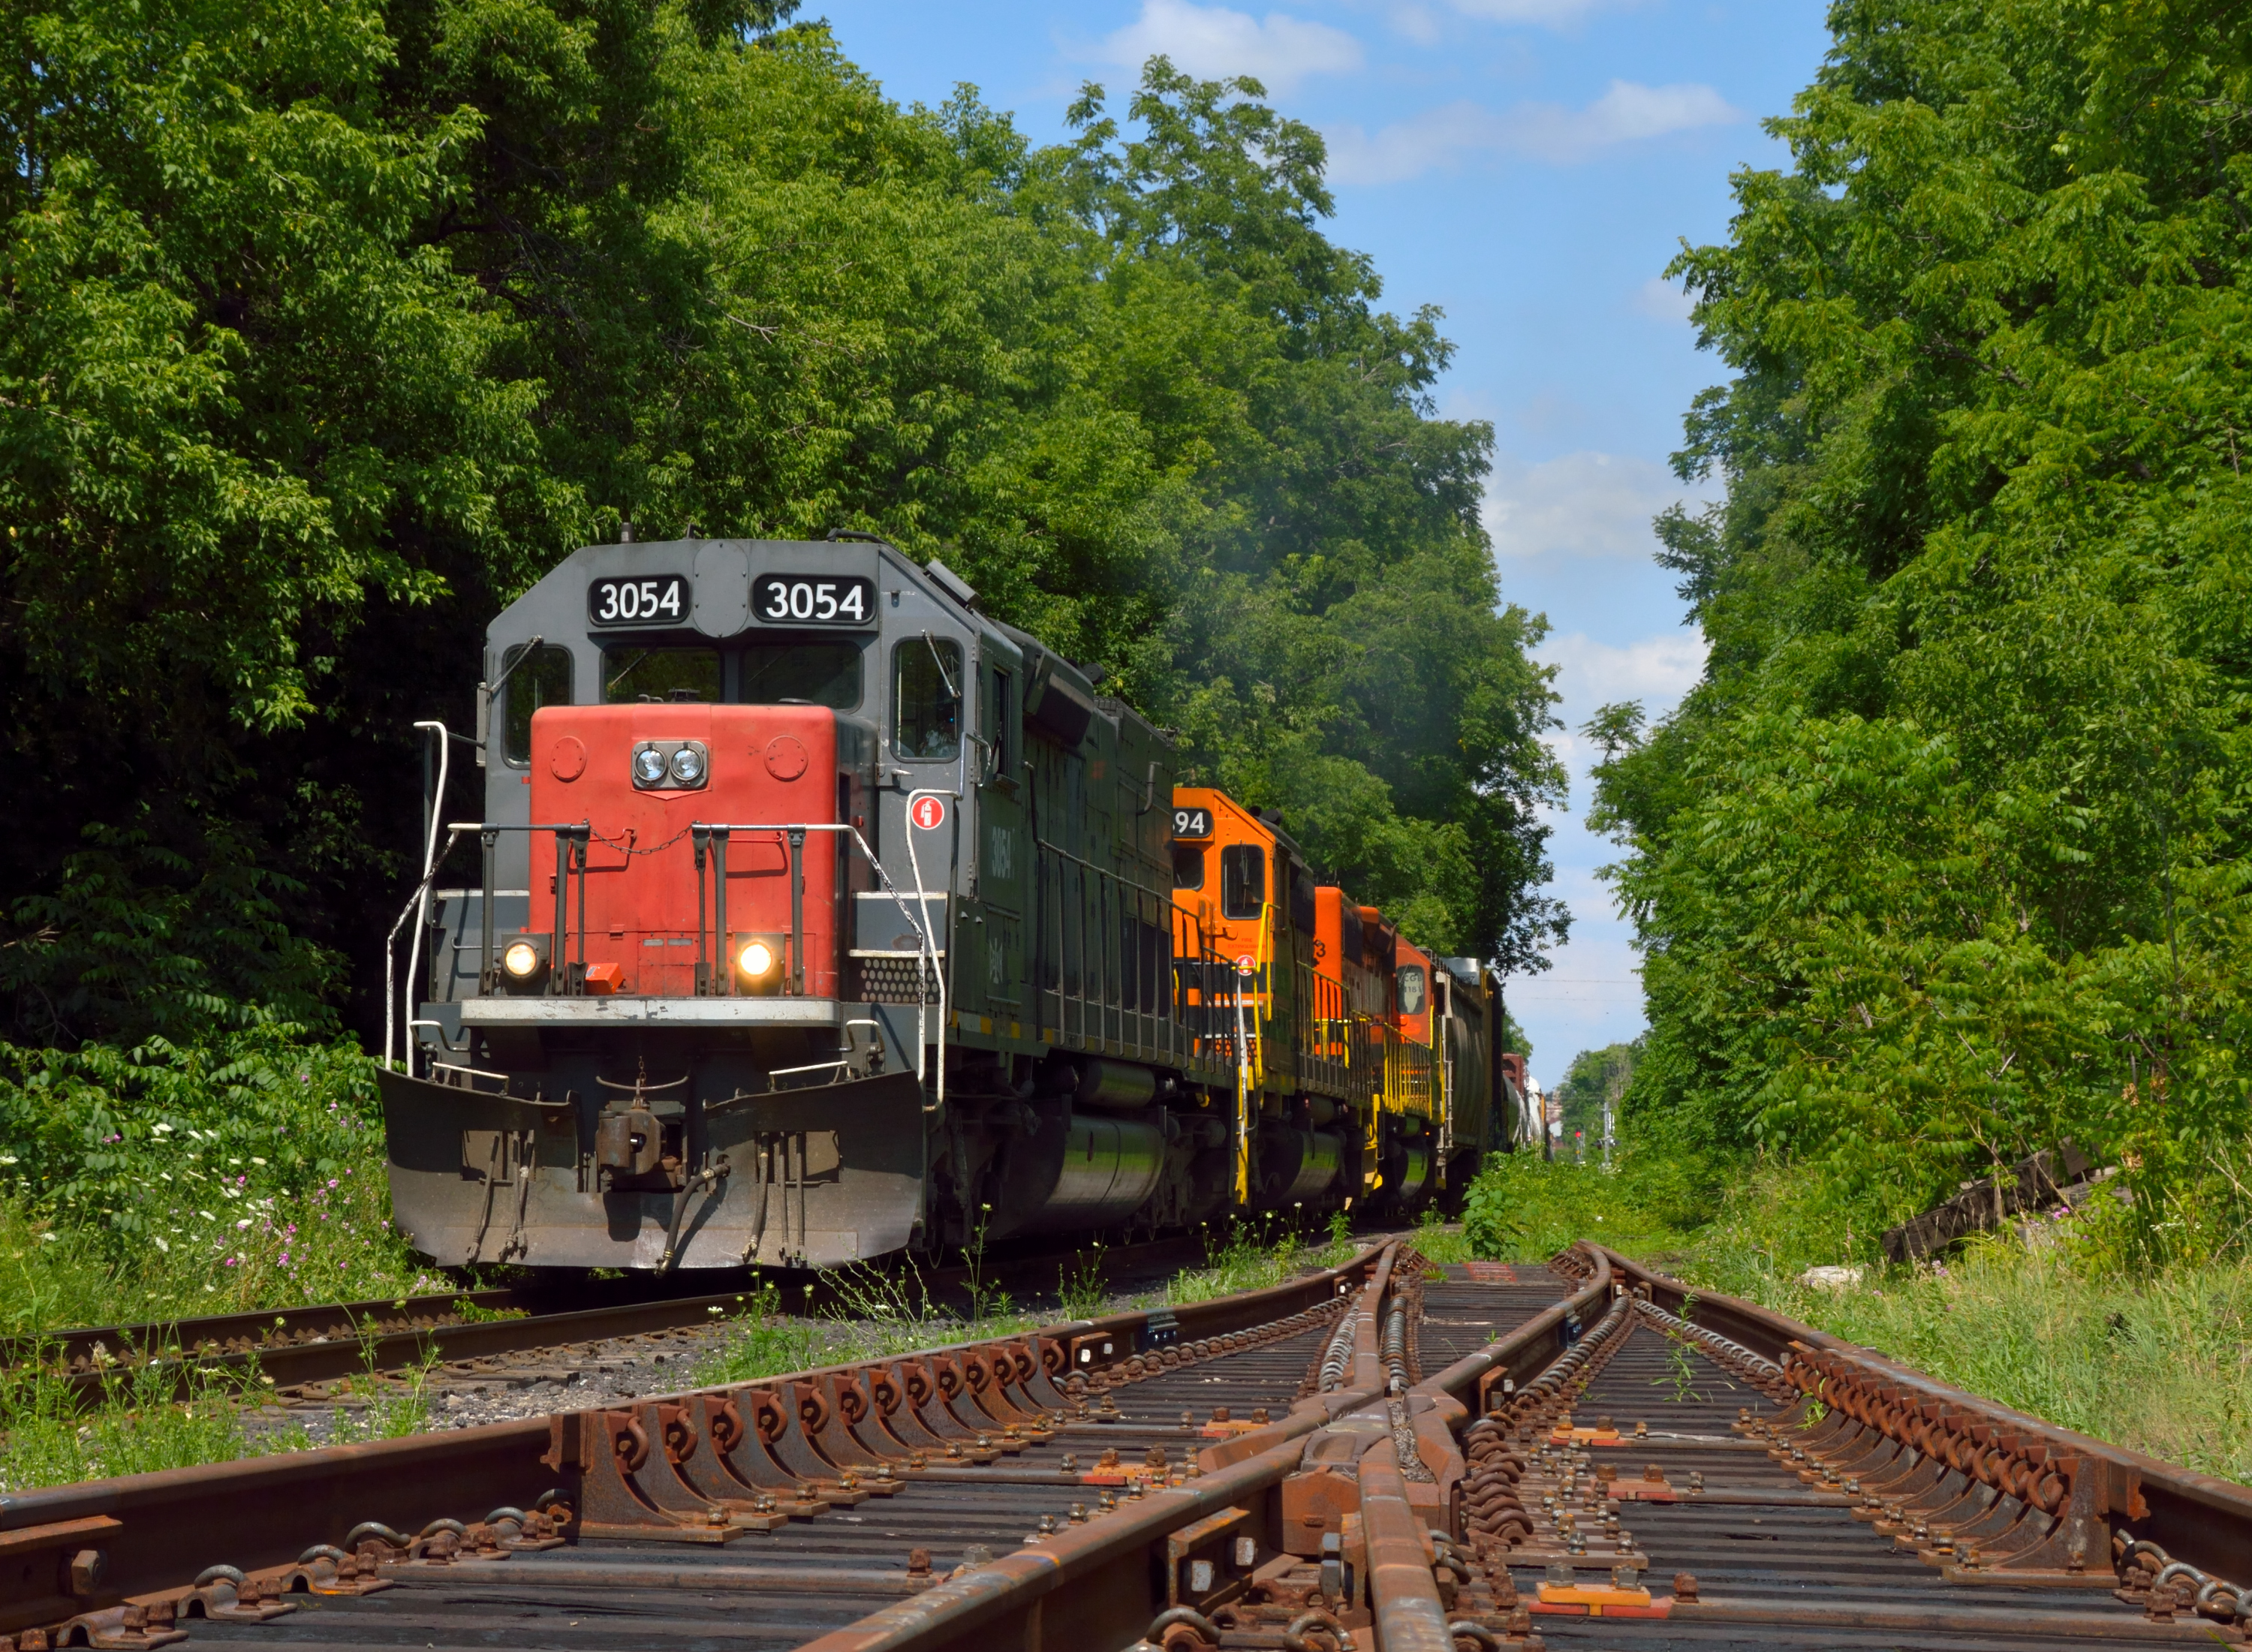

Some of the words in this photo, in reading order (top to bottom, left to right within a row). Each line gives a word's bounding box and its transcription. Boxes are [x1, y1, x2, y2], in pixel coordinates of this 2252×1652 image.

[599, 580, 680, 618] 3054
[766, 582, 864, 620] 3054
[1173, 811, 1204, 834] 94
[992, 826, 1011, 879] 3054
[782, 1082, 788, 1091] 2
